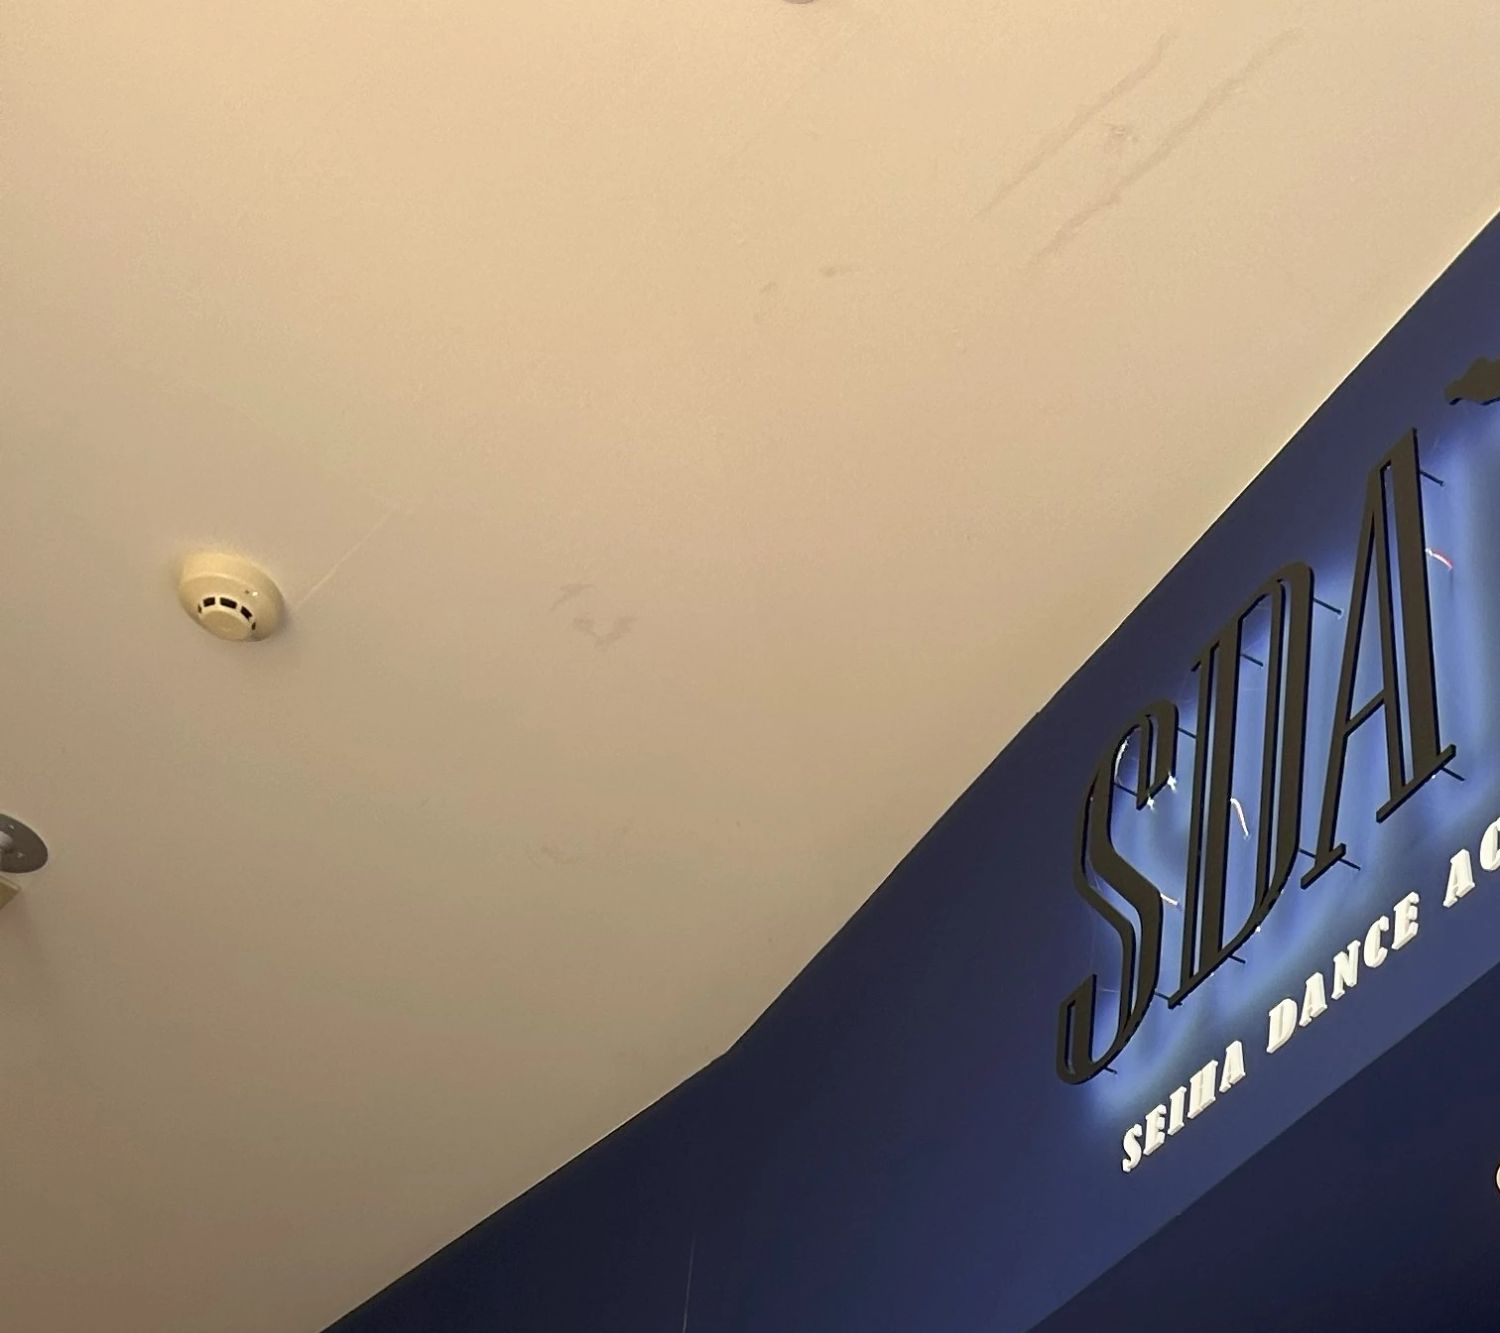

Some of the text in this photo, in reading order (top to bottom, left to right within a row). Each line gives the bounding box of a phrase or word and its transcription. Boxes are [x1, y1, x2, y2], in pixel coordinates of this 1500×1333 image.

[1056, 428, 1457, 1086] SDA
[1121, 1038, 1247, 1173] SEIHA
[1266, 890, 1421, 1055] DANCE
